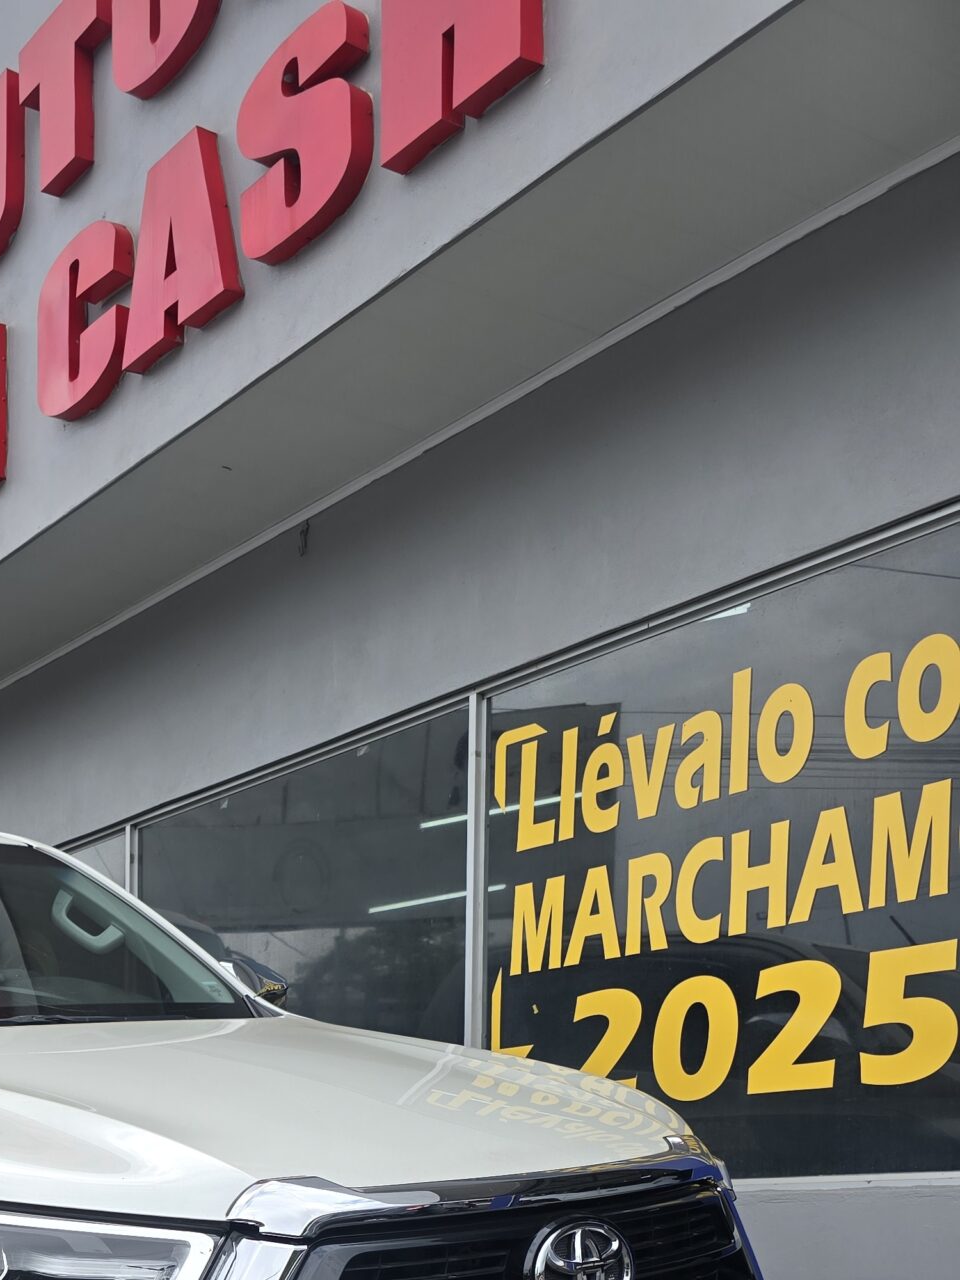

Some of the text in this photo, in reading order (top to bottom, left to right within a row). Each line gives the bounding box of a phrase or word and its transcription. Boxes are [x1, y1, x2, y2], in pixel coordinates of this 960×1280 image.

[516, 667, 814, 853] Llévalo
[509, 777, 960, 977] MARCHAM
[572, 938, 959, 1102] 2025
